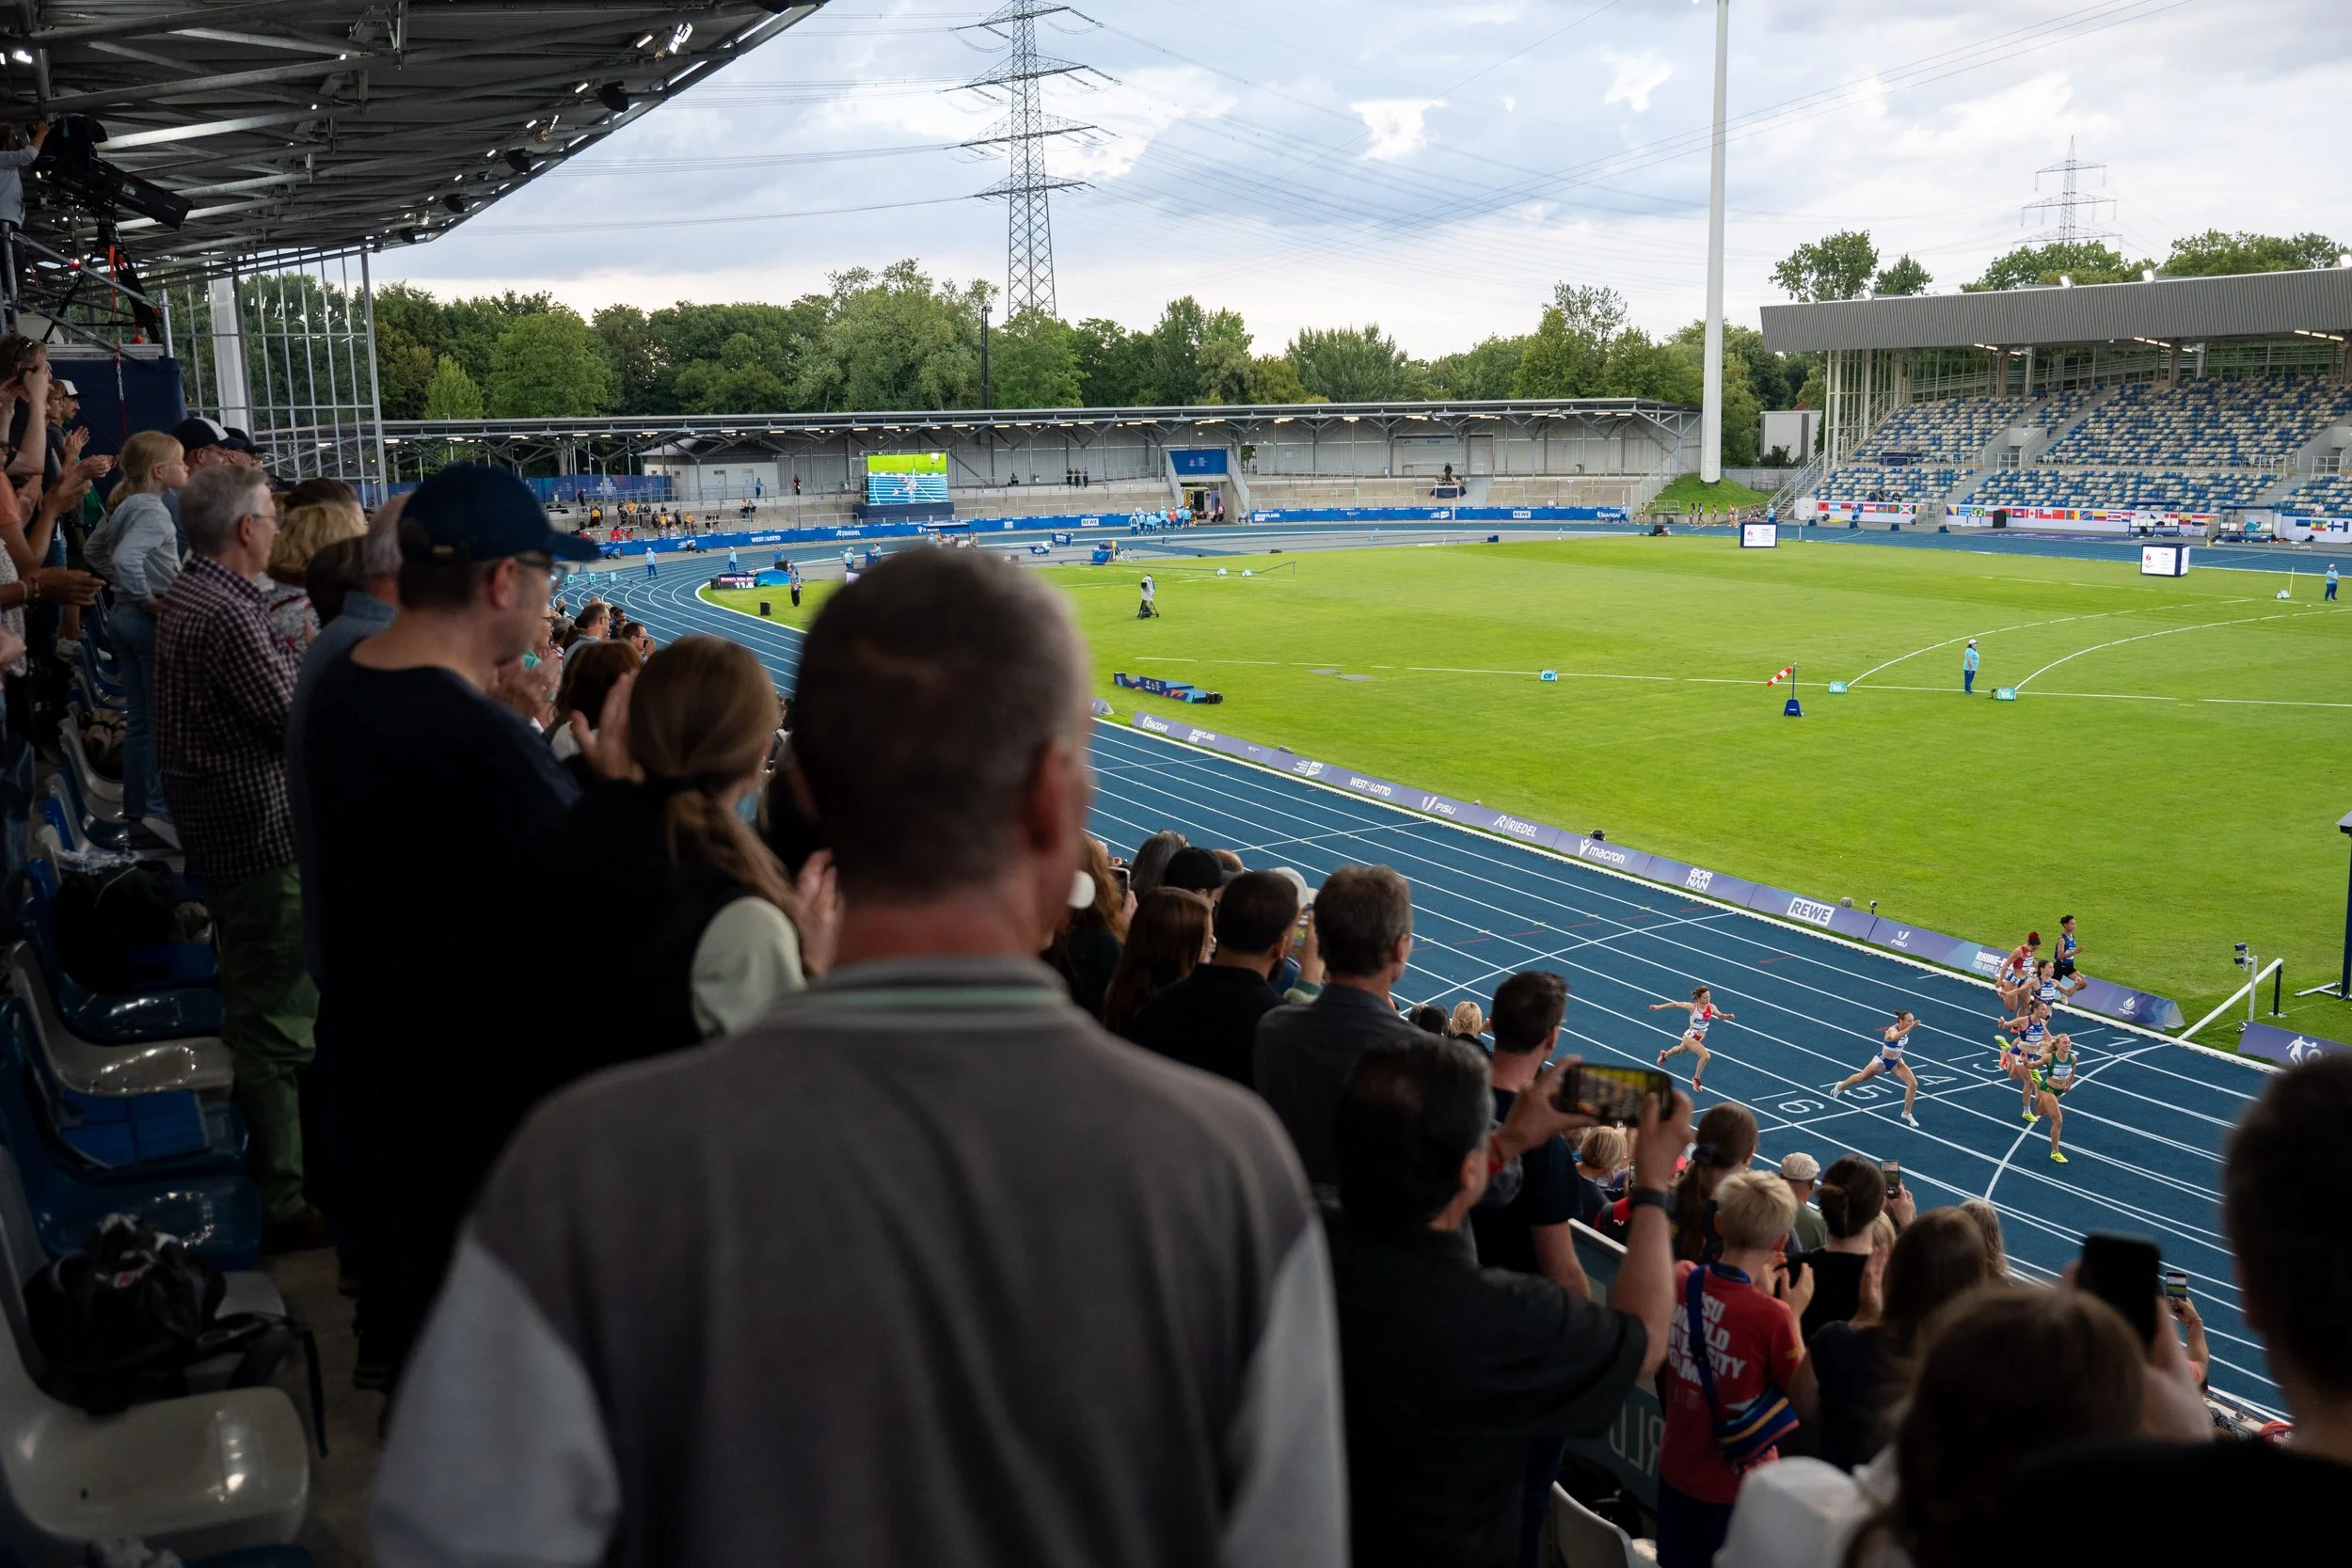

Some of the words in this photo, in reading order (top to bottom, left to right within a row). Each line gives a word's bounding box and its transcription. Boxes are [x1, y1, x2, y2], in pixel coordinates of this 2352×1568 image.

[1435, 802, 1456, 816] FISU
[1507, 819, 1537, 837] RIEDEL
[1588, 845, 1626, 864] macron
[1790, 900, 1831, 923] REWE
[1844, 1084, 1894, 1100] 5
[1778, 1099, 1825, 1114] 6
